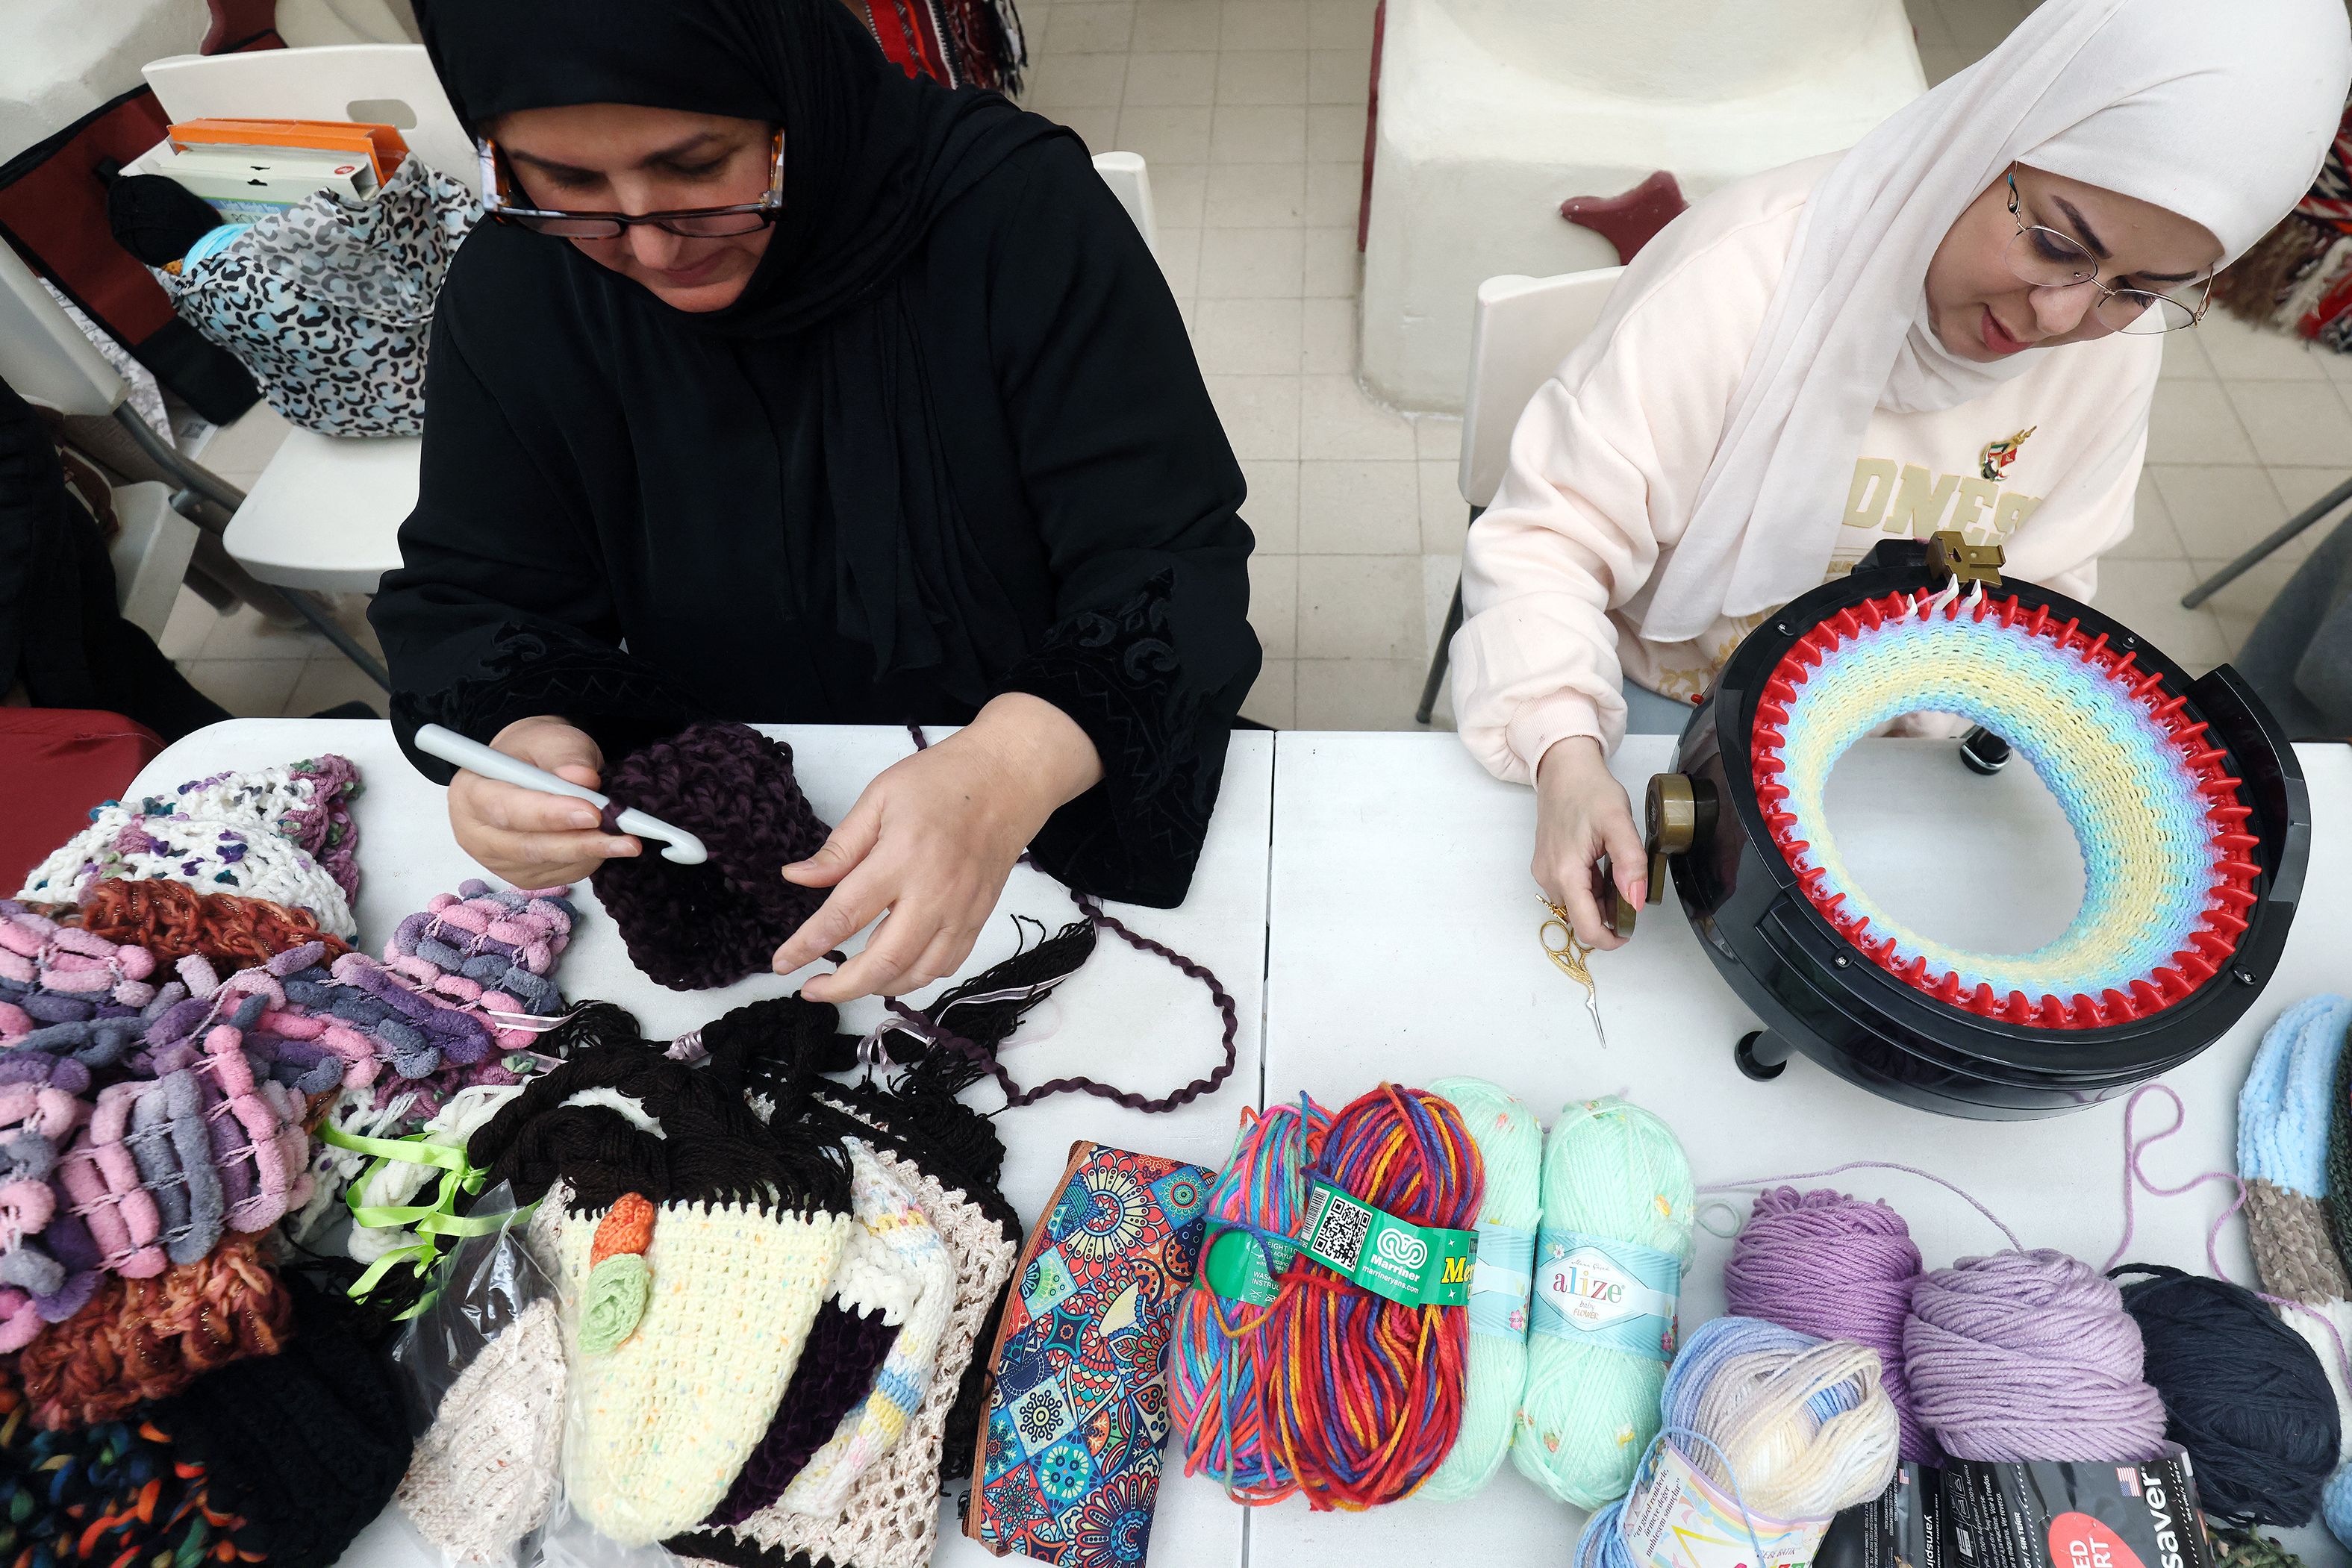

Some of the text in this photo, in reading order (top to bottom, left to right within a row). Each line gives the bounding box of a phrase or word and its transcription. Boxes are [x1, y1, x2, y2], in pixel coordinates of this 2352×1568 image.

[1370, 1253, 1420, 1283] Marriner
[1553, 1266, 1622, 1303] alize
[1573, 1308, 1599, 1320] FLOWER
[1579, 1301, 1596, 1311] baby
[1641, 1503, 1653, 1525] güzel
[2018, 1536, 2028, 1551] SIN
